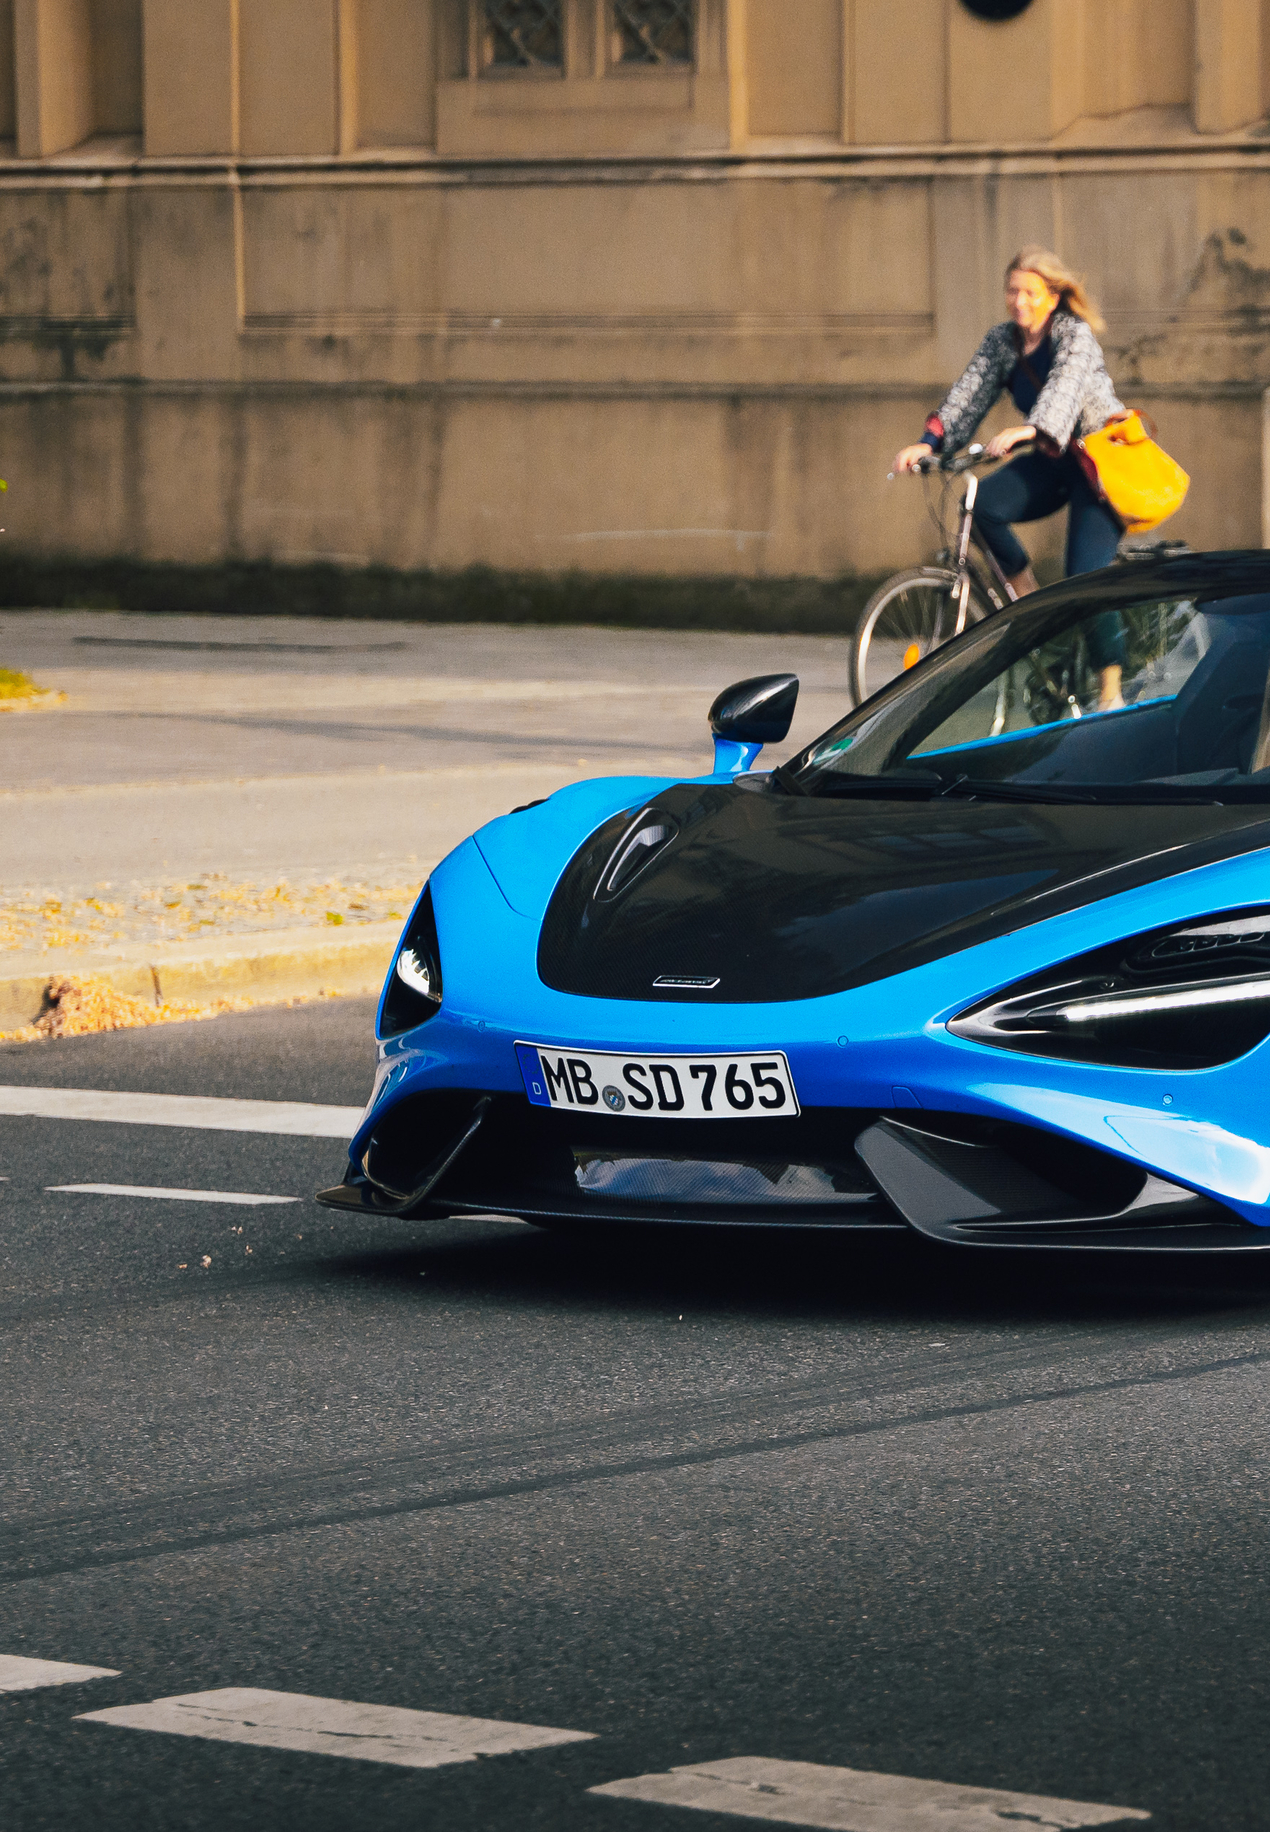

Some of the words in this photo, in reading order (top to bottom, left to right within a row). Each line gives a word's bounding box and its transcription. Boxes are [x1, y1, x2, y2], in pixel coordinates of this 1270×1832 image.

[532, 1082, 541, 1095] D
[540, 1055, 599, 1105] MB
[622, 1063, 685, 1111] SD
[689, 1062, 786, 1111] 765
